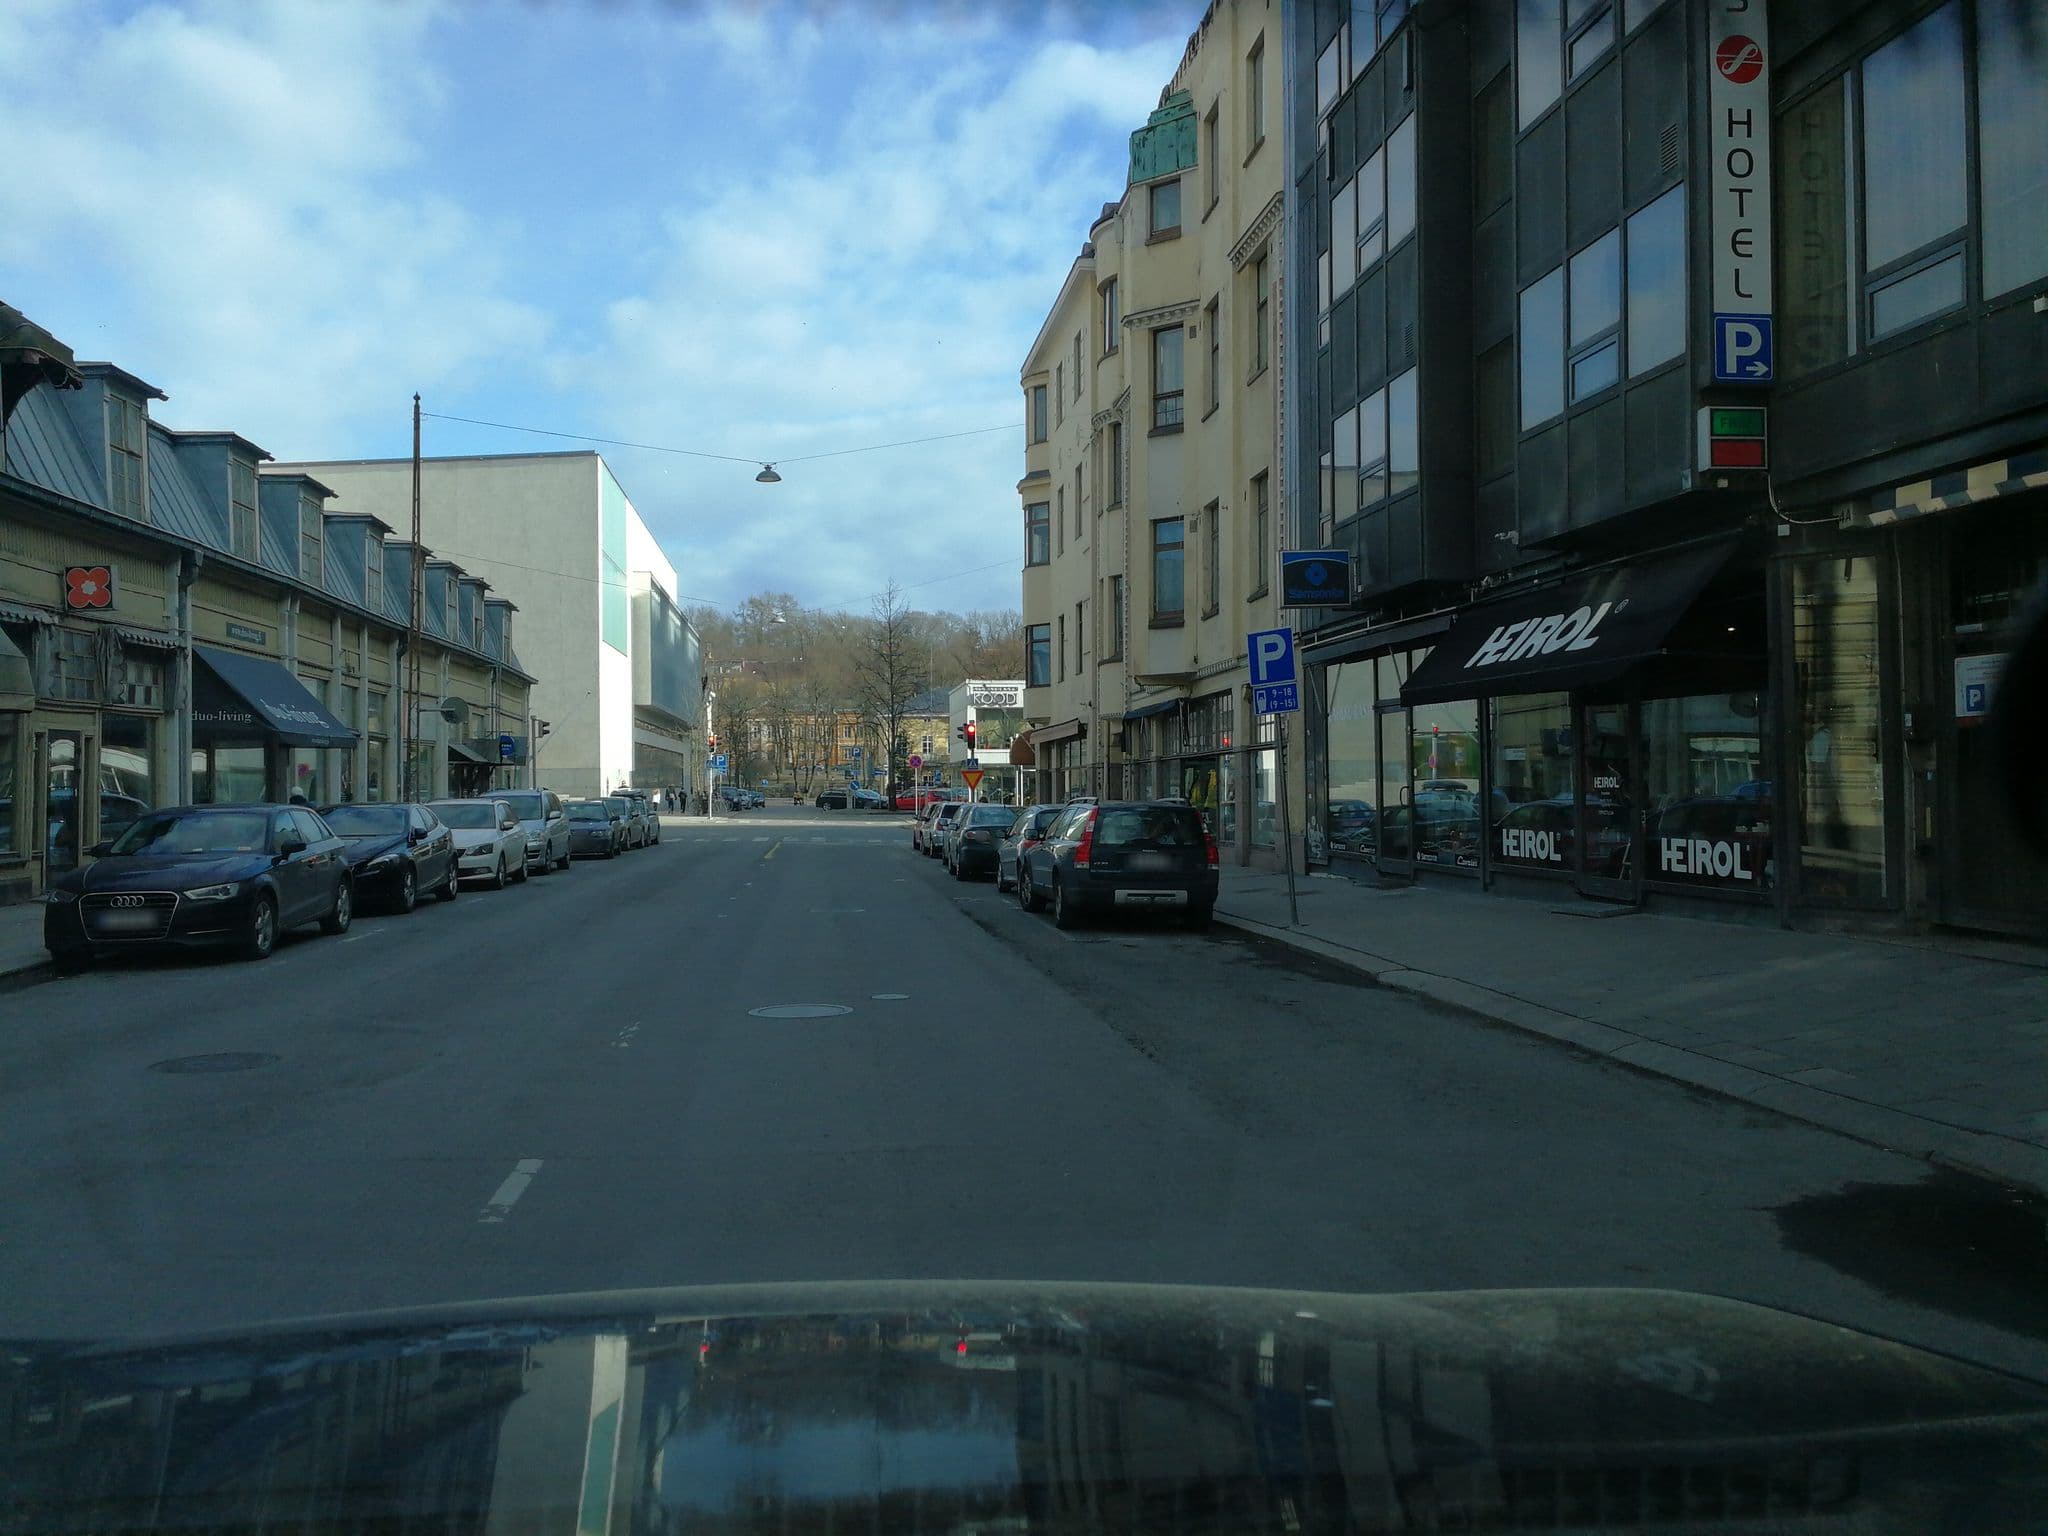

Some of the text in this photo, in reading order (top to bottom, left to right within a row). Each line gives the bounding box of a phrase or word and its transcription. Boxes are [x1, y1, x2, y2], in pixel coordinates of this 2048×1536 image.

[1727, 108, 1753, 298] HOTEL
[1725, 322, 1762, 374] P
[1463, 601, 1612, 669] HEIROL
[1256, 633, 1286, 681] P
[1271, 687, 1292, 698] 9-18
[1969, 689, 1982, 707] P
[192, 709, 252, 723] duo-living
[716, 755, 725, 766] P
[1593, 776, 1620, 788] HEIROL
[1502, 828, 1562, 862] HEIROL
[1661, 837, 1753, 880] HEIROL
